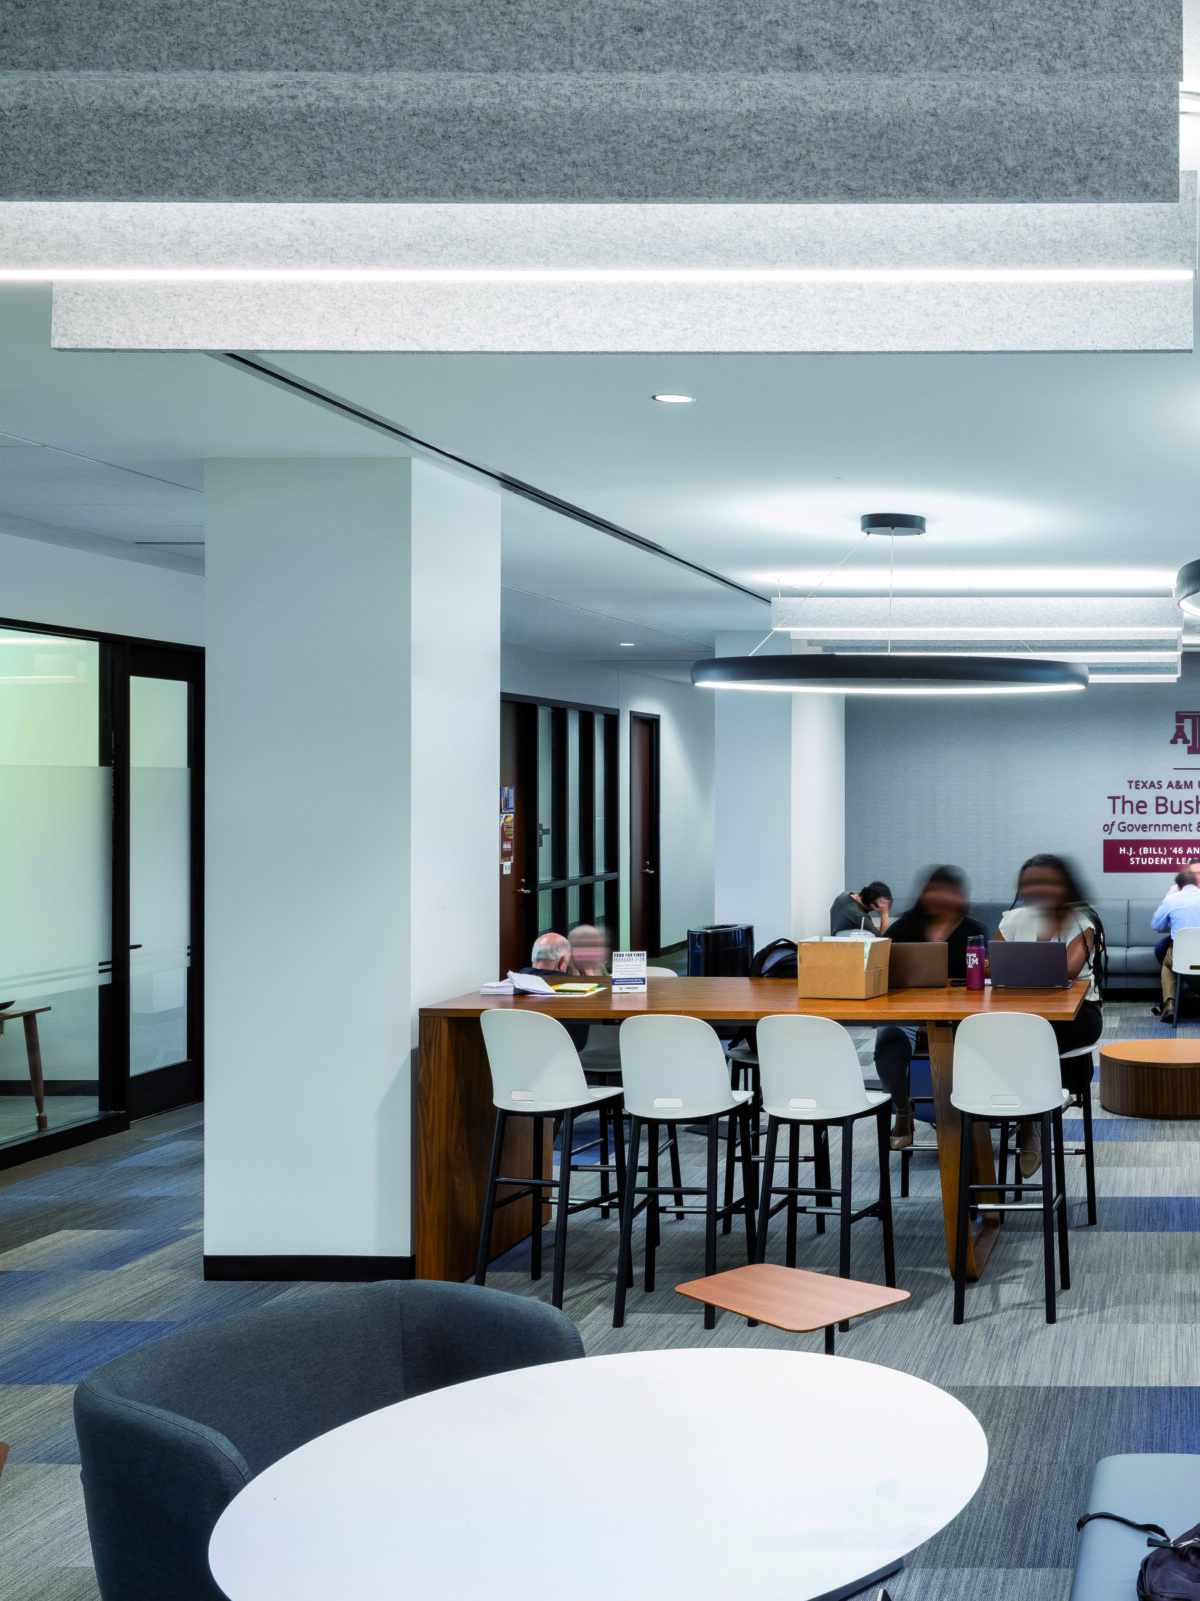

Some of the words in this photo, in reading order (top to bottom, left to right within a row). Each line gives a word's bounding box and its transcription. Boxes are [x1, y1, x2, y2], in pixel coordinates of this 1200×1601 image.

[1127, 780, 1163, 790] TEXAS
[1167, 780, 1194, 790] A&M
[1107, 795, 1148, 815] The
[1102, 821, 1115, 835] of
[1117, 821, 1193, 832] Government
[1119, 847, 1136, 855] H.J.
[1139, 846, 1167, 856] (BILL)
[1129, 857, 1173, 865] STUDENT
